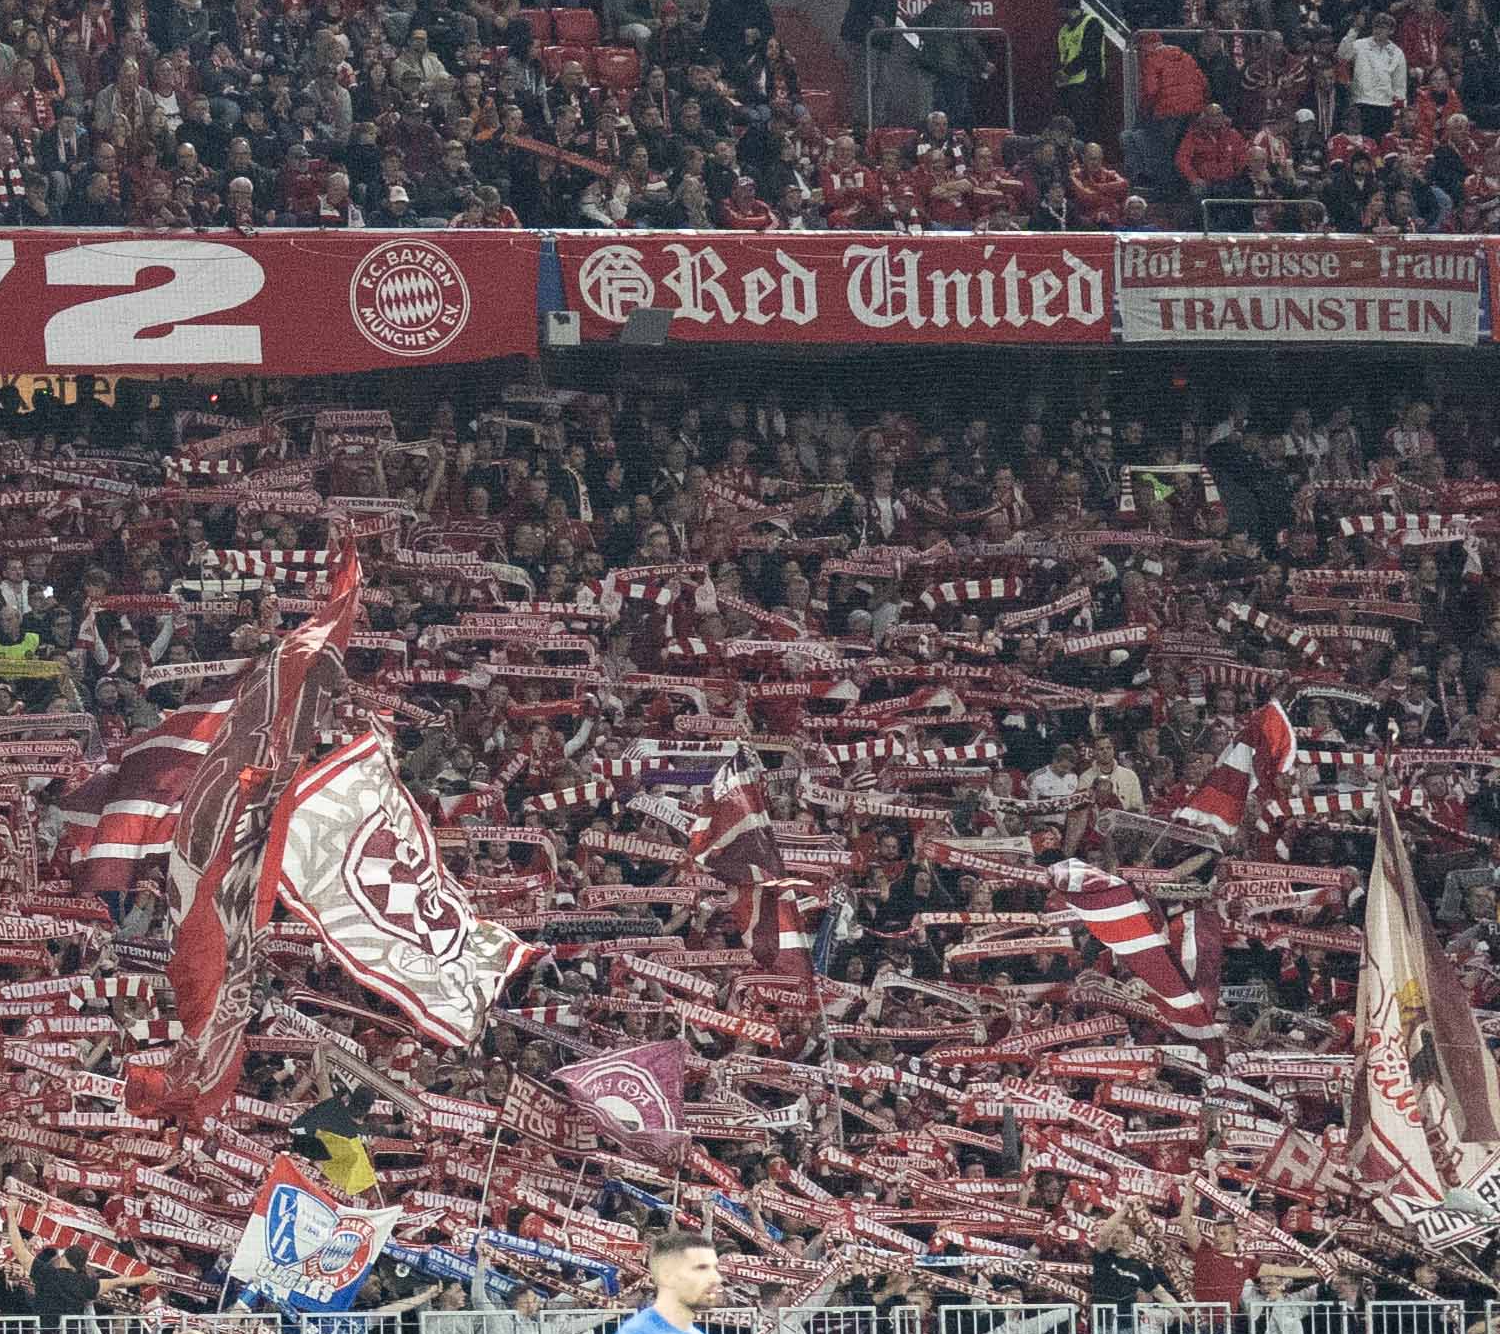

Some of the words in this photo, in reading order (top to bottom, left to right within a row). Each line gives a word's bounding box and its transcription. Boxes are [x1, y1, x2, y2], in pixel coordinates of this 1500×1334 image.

[361, 262, 387, 288] F.C.
[386, 251, 456, 289] BAYERN
[1123, 247, 1184, 279] Rot
[1219, 249, 1340, 279] Weisse
[1379, 247, 1477, 282] Traun
[661, 244, 819, 325] Red
[843, 244, 1104, 329] United
[360, 307, 441, 345] MÜNCHEN
[1151, 298, 1451, 333] TRAUNSTEIN
